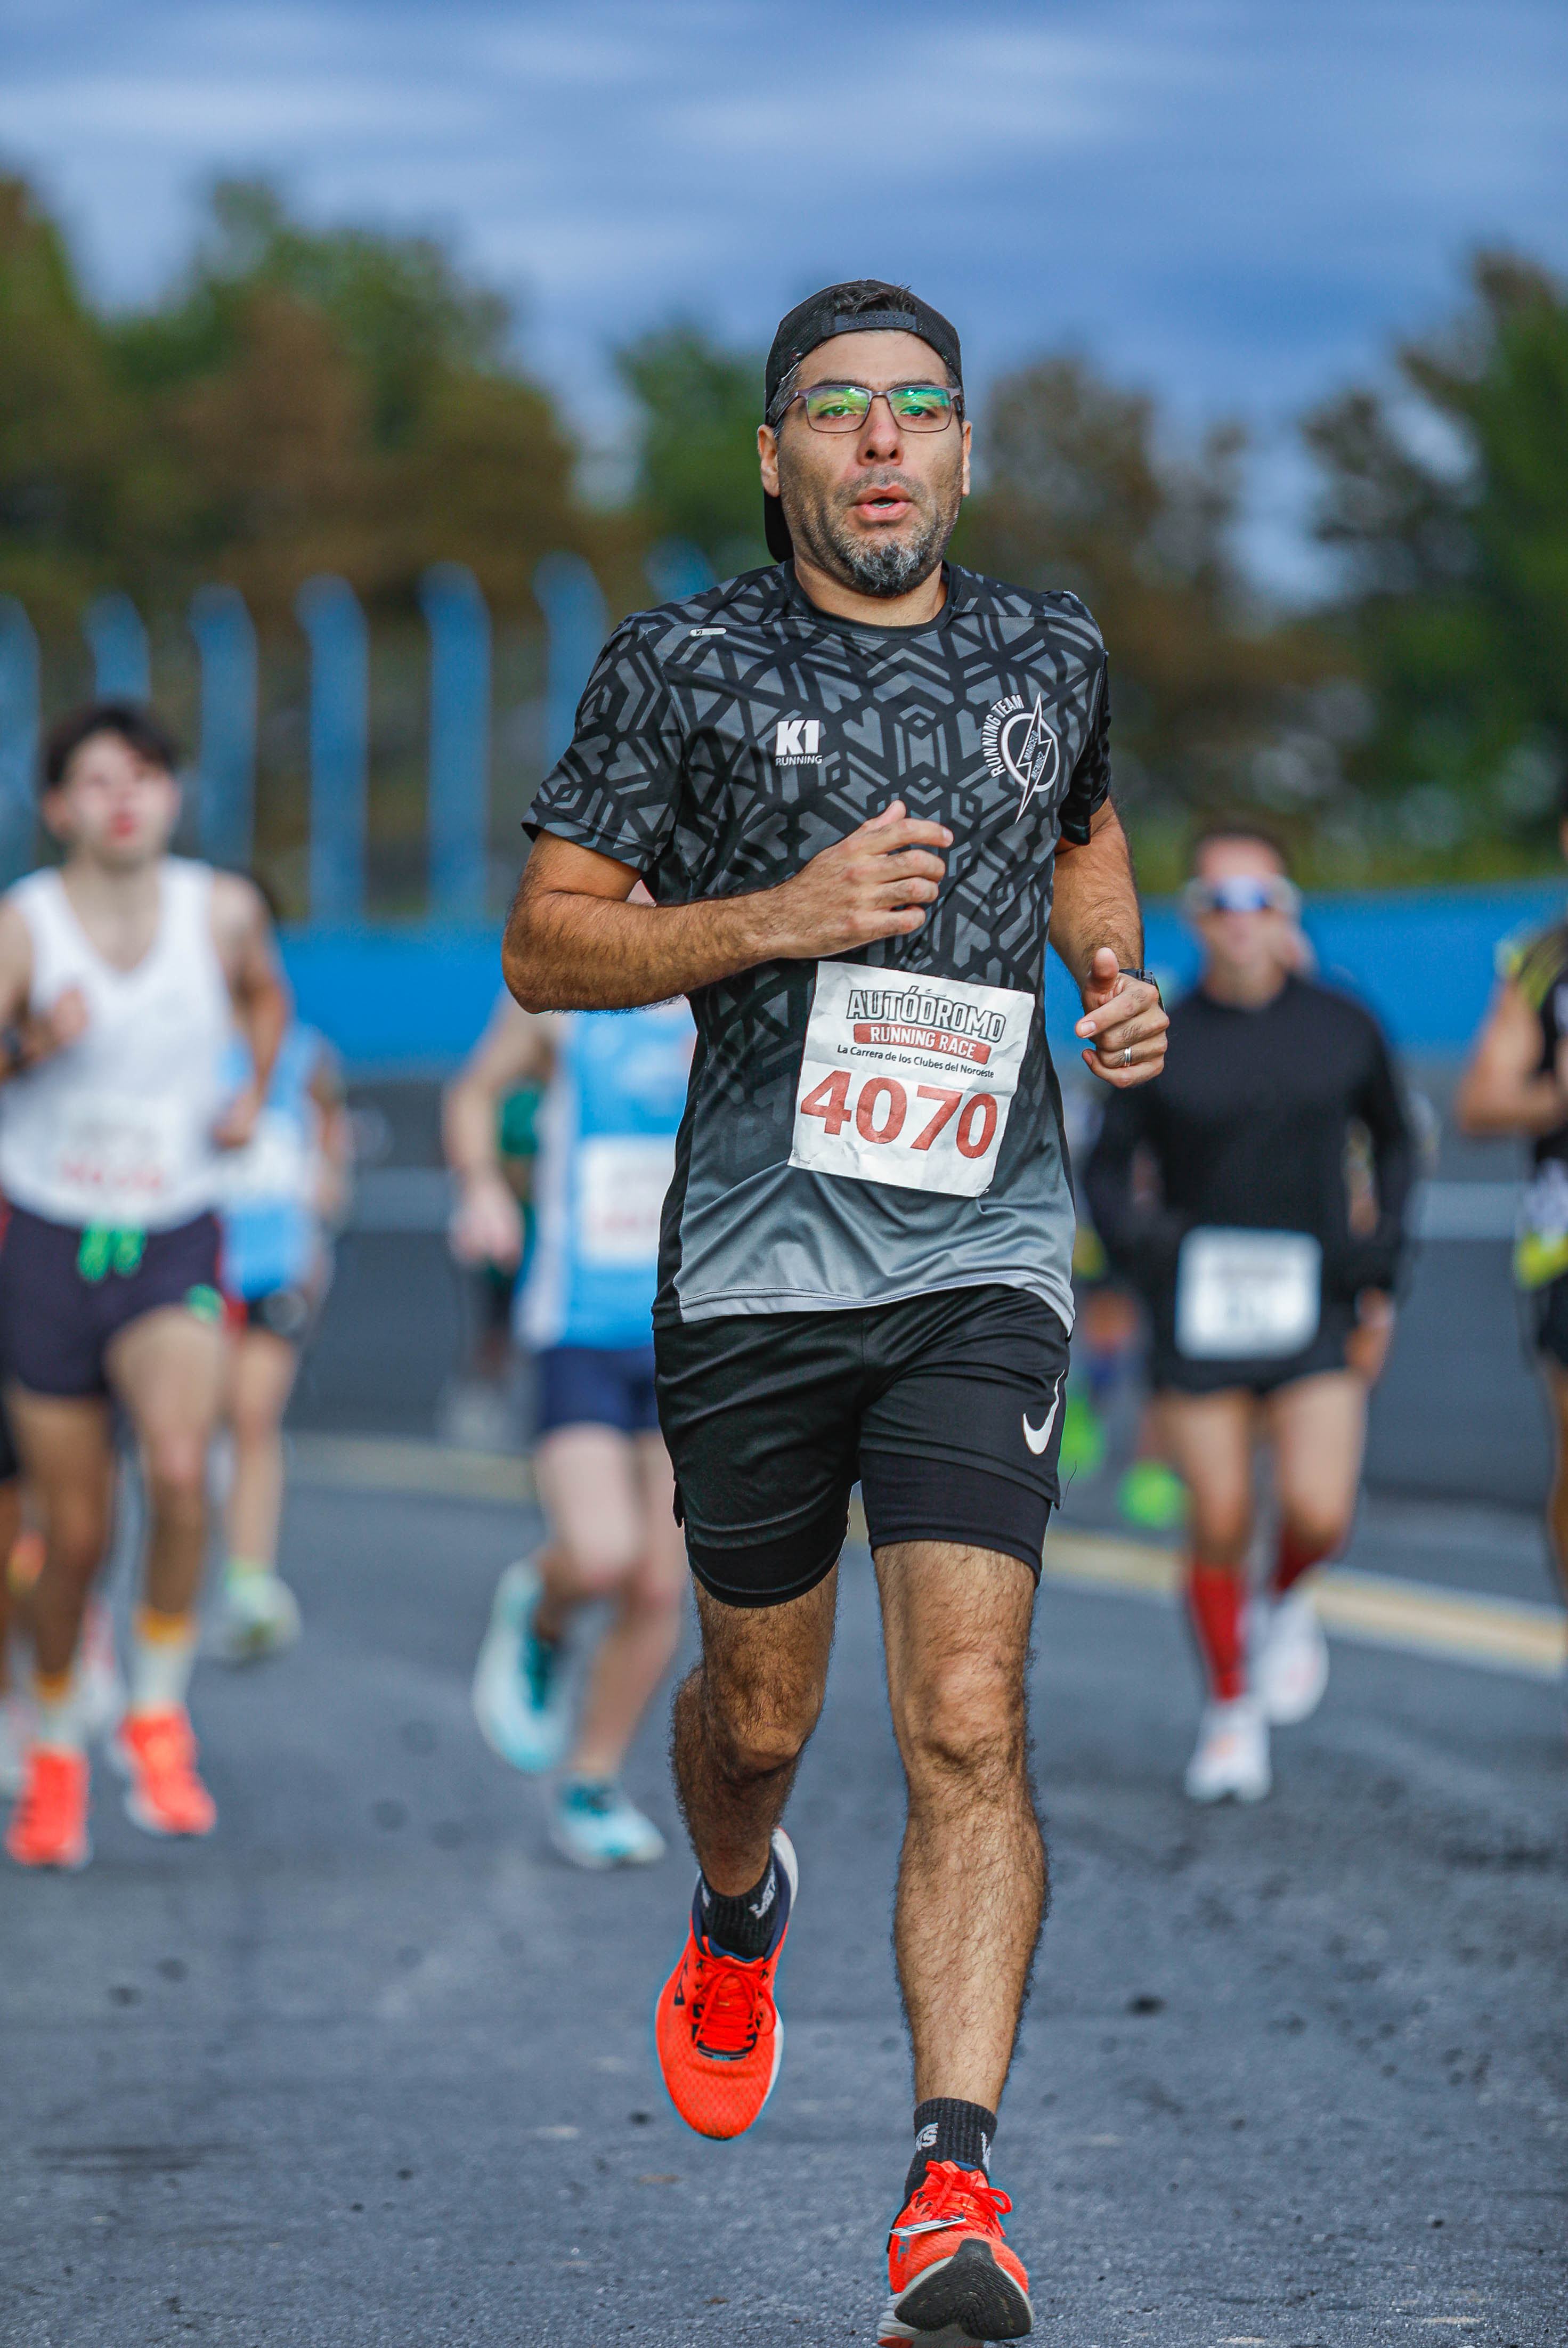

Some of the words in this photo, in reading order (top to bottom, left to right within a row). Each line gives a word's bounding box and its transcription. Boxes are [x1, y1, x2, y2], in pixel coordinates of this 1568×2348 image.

[990, 694, 1025, 718] TEAM
[775, 755, 823, 767] RUNNING
[981, 714, 1006, 778] RUNNING
[847, 986, 1006, 1043] AUTÓDROMO
[870, 1026, 936, 1047] RUNNING
[939, 1034, 977, 1059] RACE
[838, 1044, 848, 1053] La
[850, 1046, 883, 1059] Carrera
[885, 1051, 897, 1061] de
[899, 1053, 911, 1064] los
[914, 1057, 943, 1069] Clubes
[945, 1062, 958, 1072] del
[960, 1065, 994, 1078] Noroeste
[801, 1070, 998, 1159] 4070
